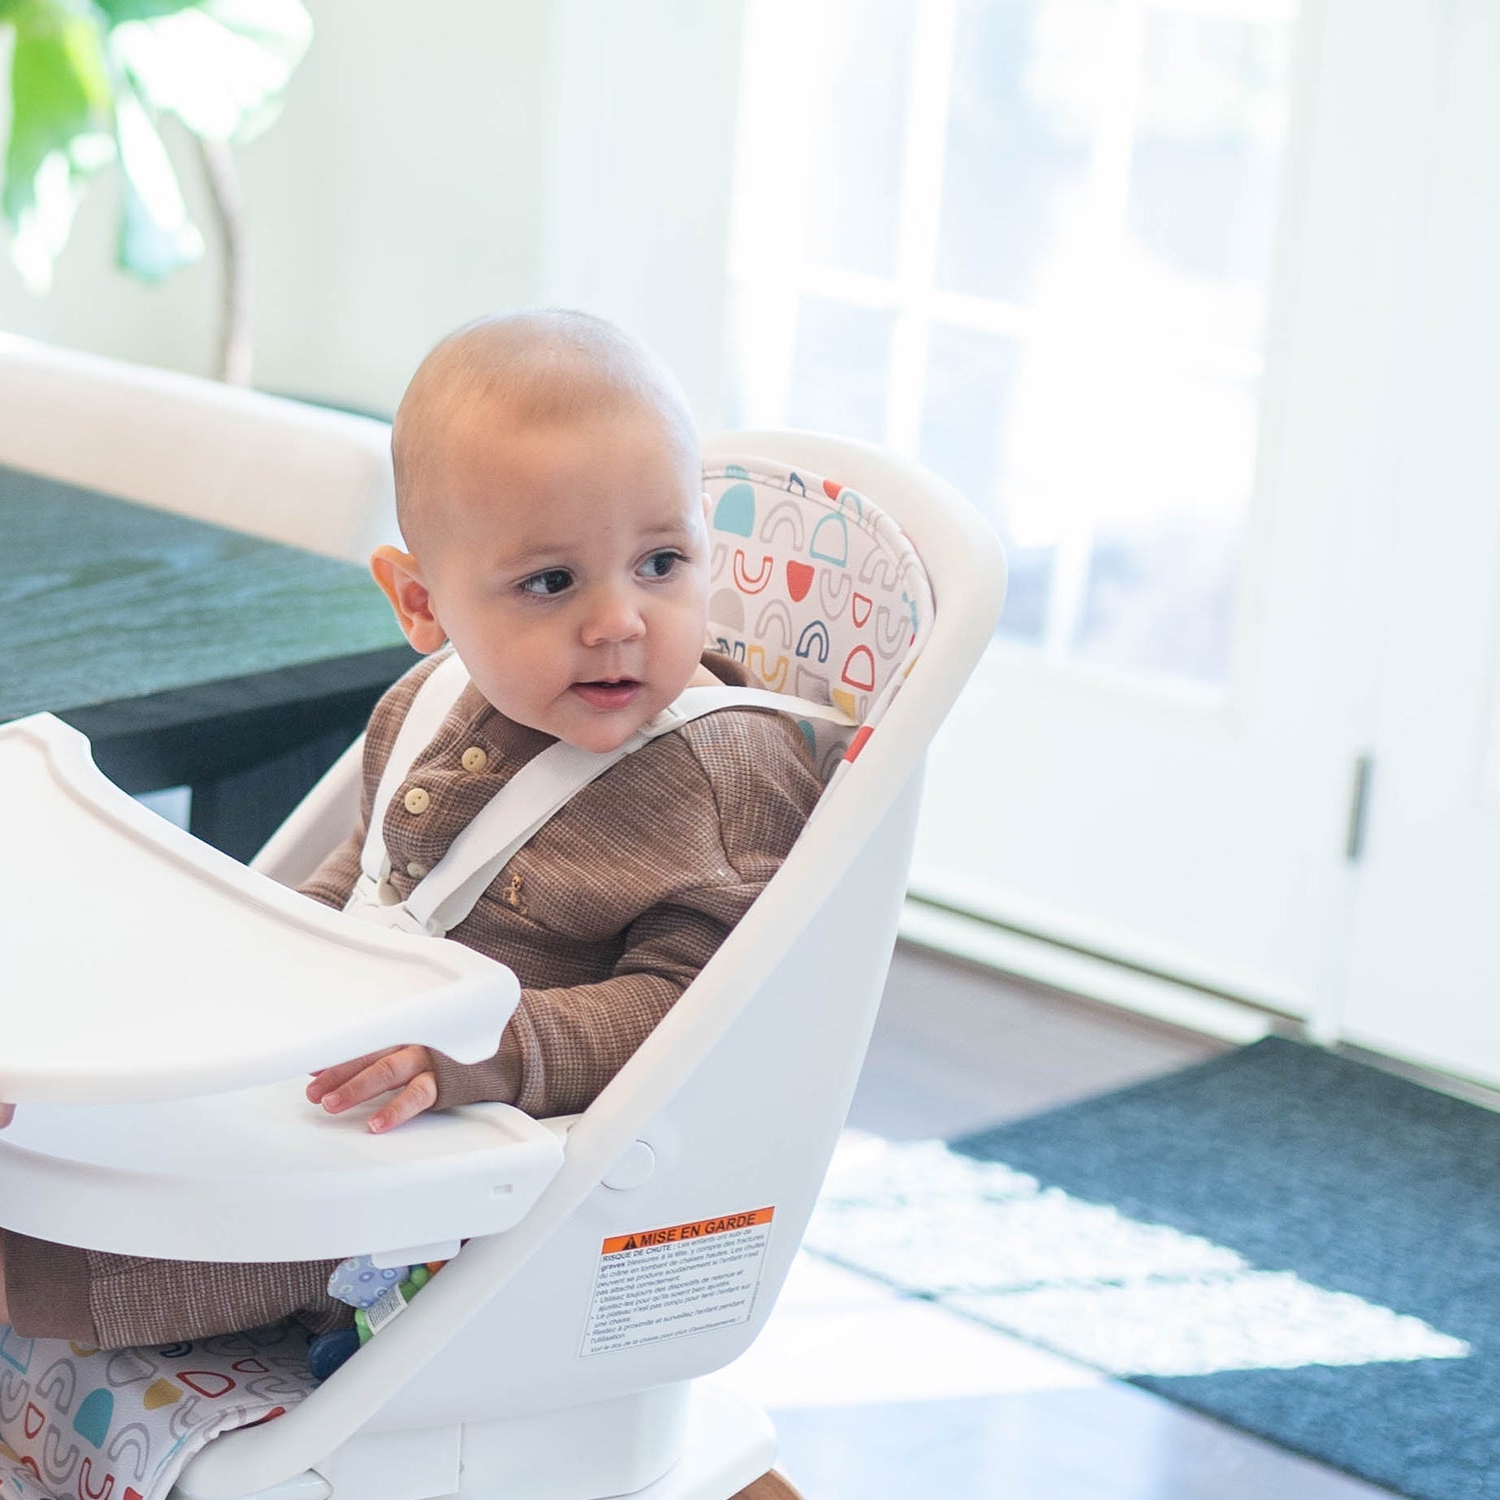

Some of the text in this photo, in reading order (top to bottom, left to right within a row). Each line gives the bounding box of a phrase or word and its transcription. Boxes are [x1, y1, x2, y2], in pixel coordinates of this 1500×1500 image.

[640, 1229, 676, 1246] MISE
[705, 1214, 755, 1234] GARDE
[601, 1263, 625, 1272] graves
[627, 1256, 659, 1266] blessures
[737, 1235, 764, 1244] fractures
[603, 1252, 631, 1261] RISQUE
[646, 1244, 671, 1254] CHUTE
[641, 1262, 668, 1271] tombant
[744, 1242, 764, 1250] chutes
[597, 1278, 625, 1288] peuvent
[636, 1271, 663, 1281] produire
[666, 1261, 711, 1275] soudainement
[600, 1294, 624, 1303] Utilisez
[626, 1289, 652, 1298] toujours
[711, 1272, 735, 1280] retenue
[610, 1284, 634, 1293] attaché
[606, 1310, 631, 1318] plateau
[635, 1297, 651, 1305] pour
[592, 1327, 616, 1336] Restez
[624, 1320, 654, 1330] proximité
[664, 1312, 693, 1322] surveillez
[719, 1300, 745, 1310] pendant
